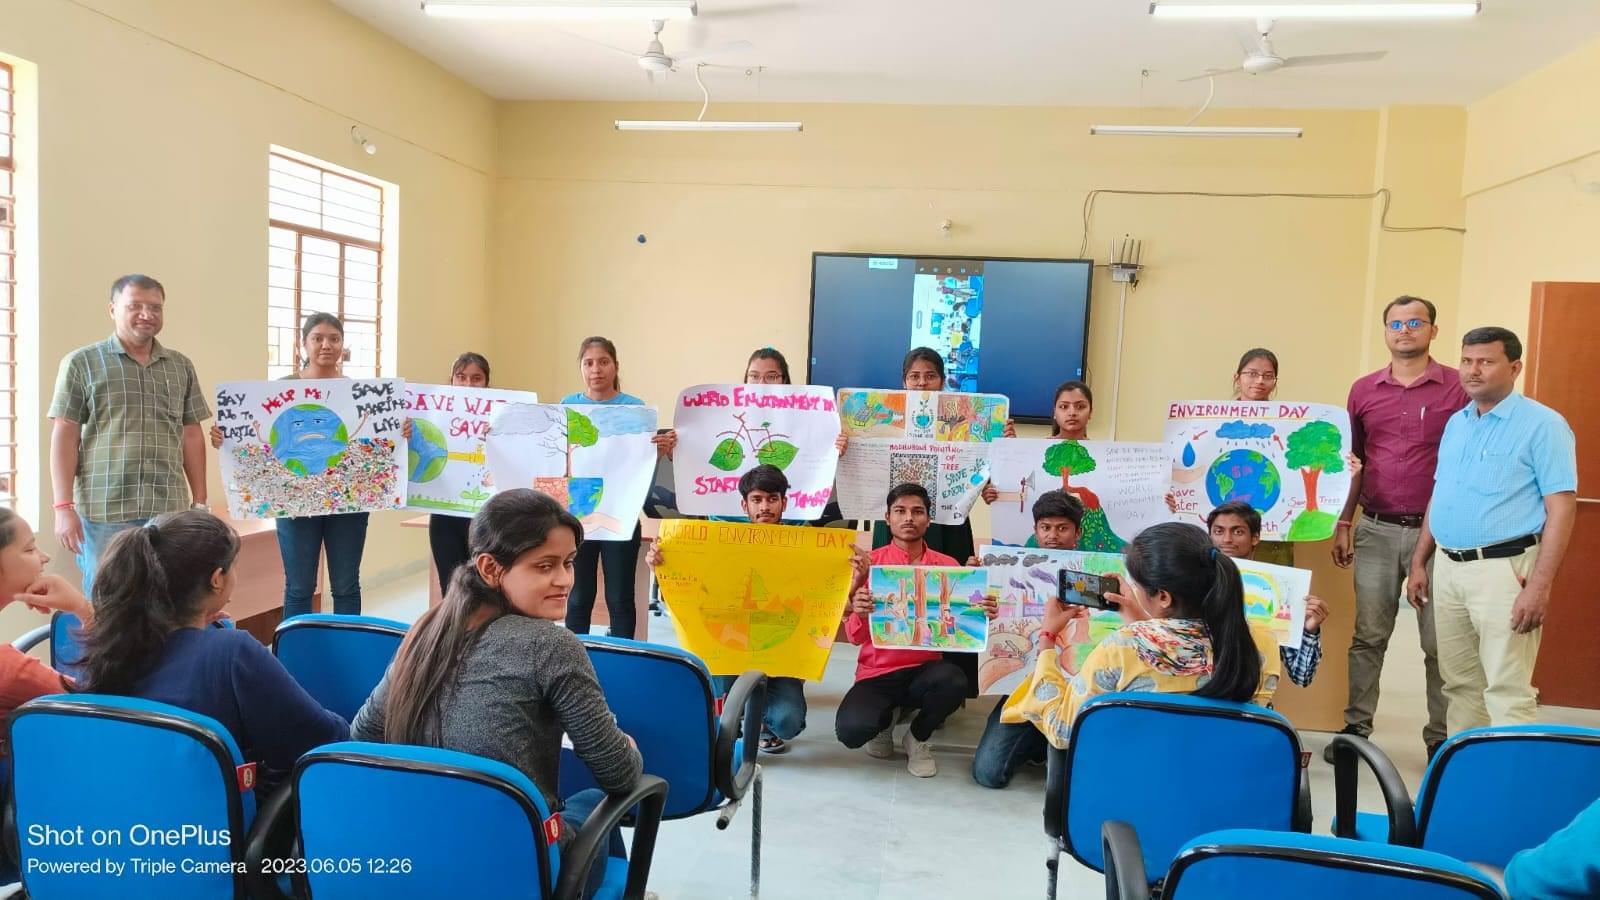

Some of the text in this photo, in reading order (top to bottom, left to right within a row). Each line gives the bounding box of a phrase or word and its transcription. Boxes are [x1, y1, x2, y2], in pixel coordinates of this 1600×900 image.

[217, 389, 246, 407] SAY
[352, 381, 394, 400] SAVE
[262, 389, 295, 415] HELP
[404, 390, 455, 412] SAVE
[1169, 403, 1310, 418] ENVIRONMENT DAY
[373, 416, 400, 434] LIFE
[449, 416, 488, 443] SAV
[945, 454, 956, 462] OF
[1170, 485, 1196, 497] Save
[1175, 499, 1199, 512] ater
[663, 525, 708, 541] WORLD
[816, 532, 848, 549] DAY
